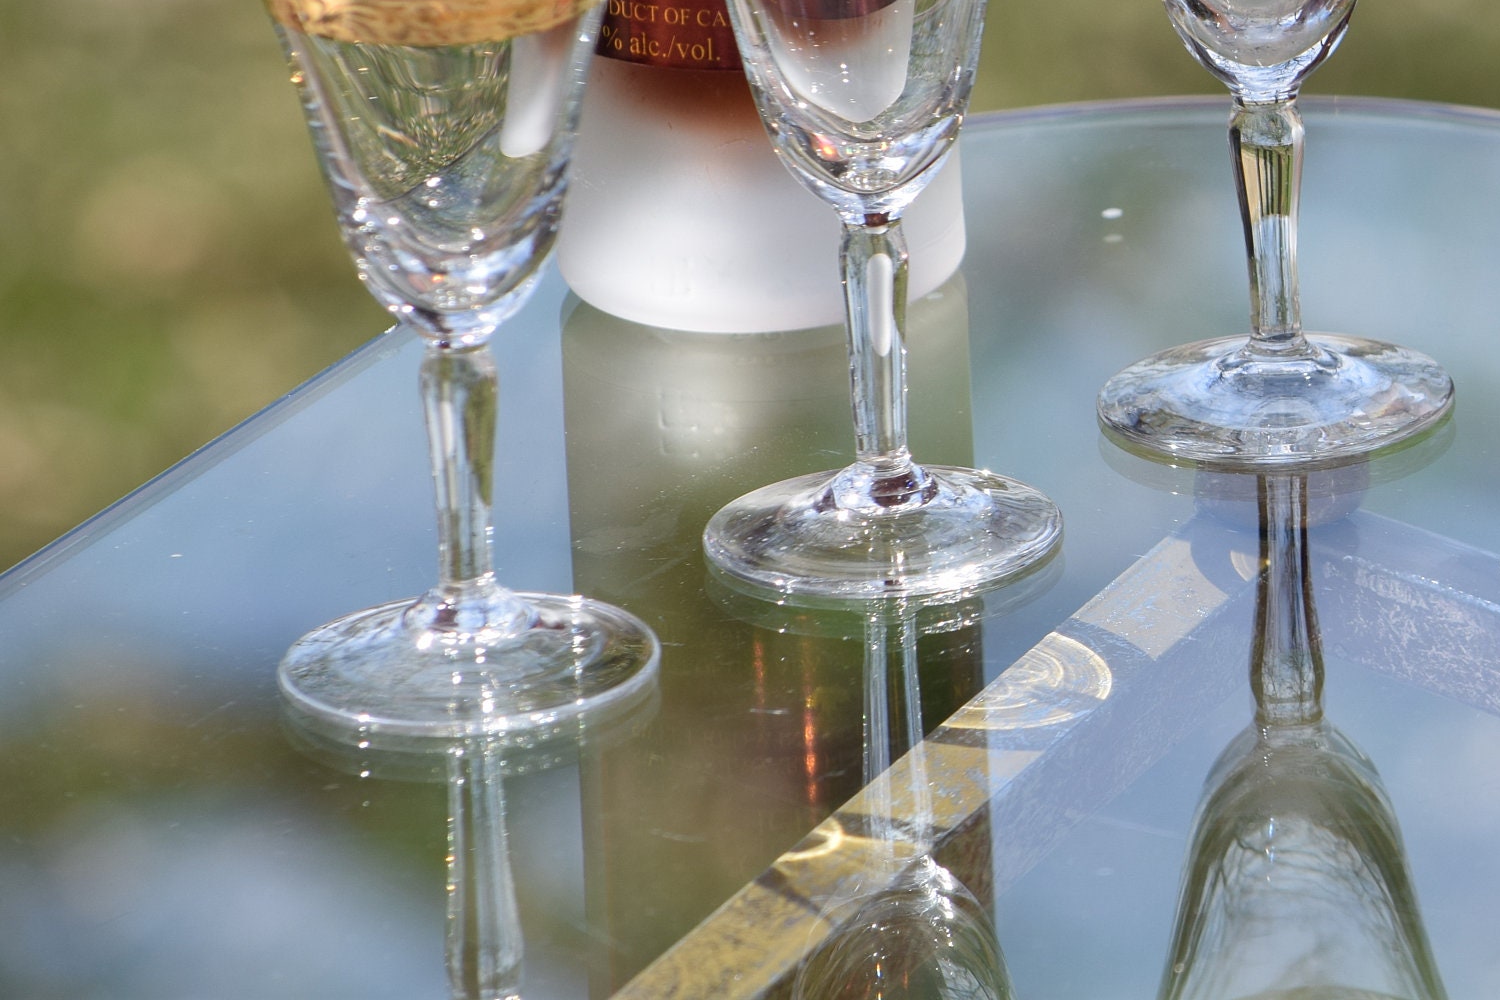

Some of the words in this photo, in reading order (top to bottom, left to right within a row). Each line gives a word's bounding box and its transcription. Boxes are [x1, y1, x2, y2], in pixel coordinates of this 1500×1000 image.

[609, 0, 658, 22] DUCT
[664, 7, 691, 25] OF
[629, 32, 721, 61] alc./vol.
